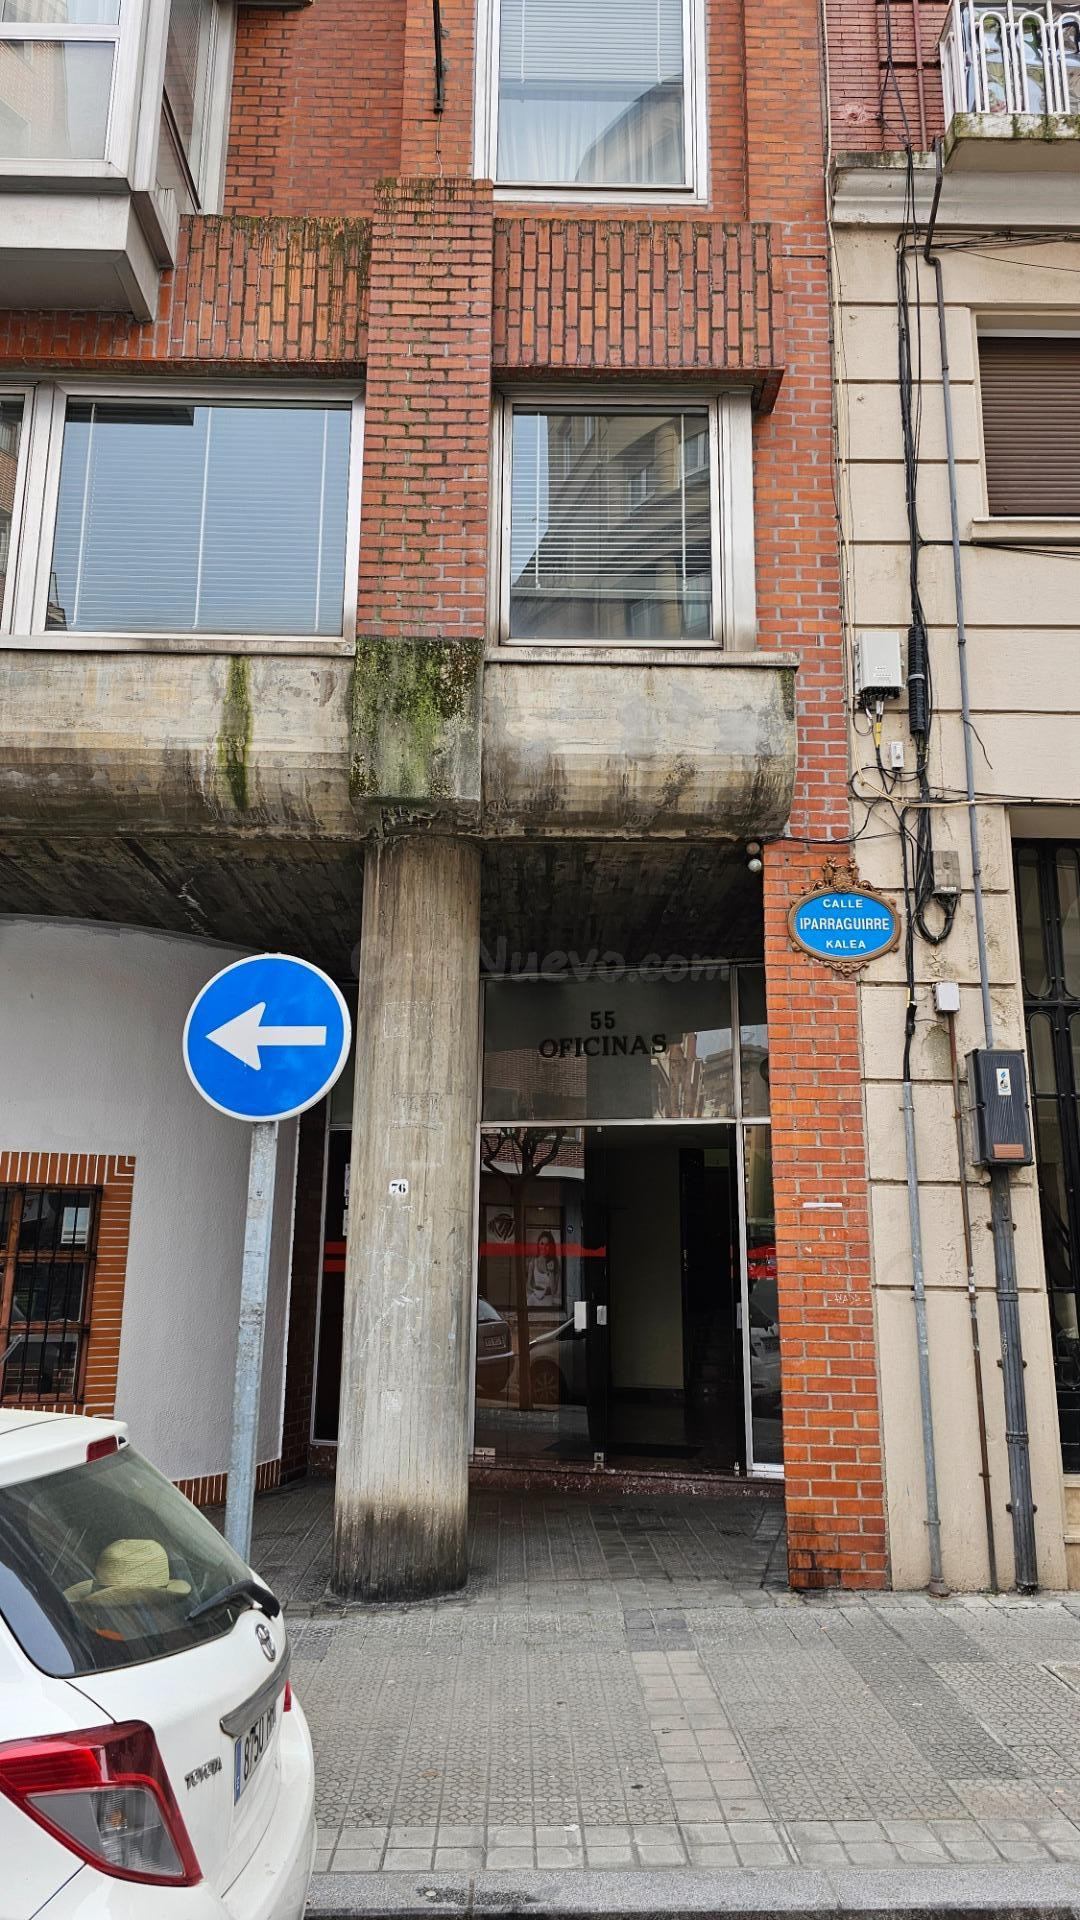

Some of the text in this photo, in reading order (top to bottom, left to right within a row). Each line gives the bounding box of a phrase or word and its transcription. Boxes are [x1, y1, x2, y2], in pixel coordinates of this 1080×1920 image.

[823, 899, 863, 908] CALLE
[800, 917, 890, 930] IPARRAGUIRRE
[826, 939, 866, 949] KALEA
[590, 1010, 615, 1030] 55
[539, 1033, 667, 1058] OFICINAS
[391, 1183, 406, 1193] 76
